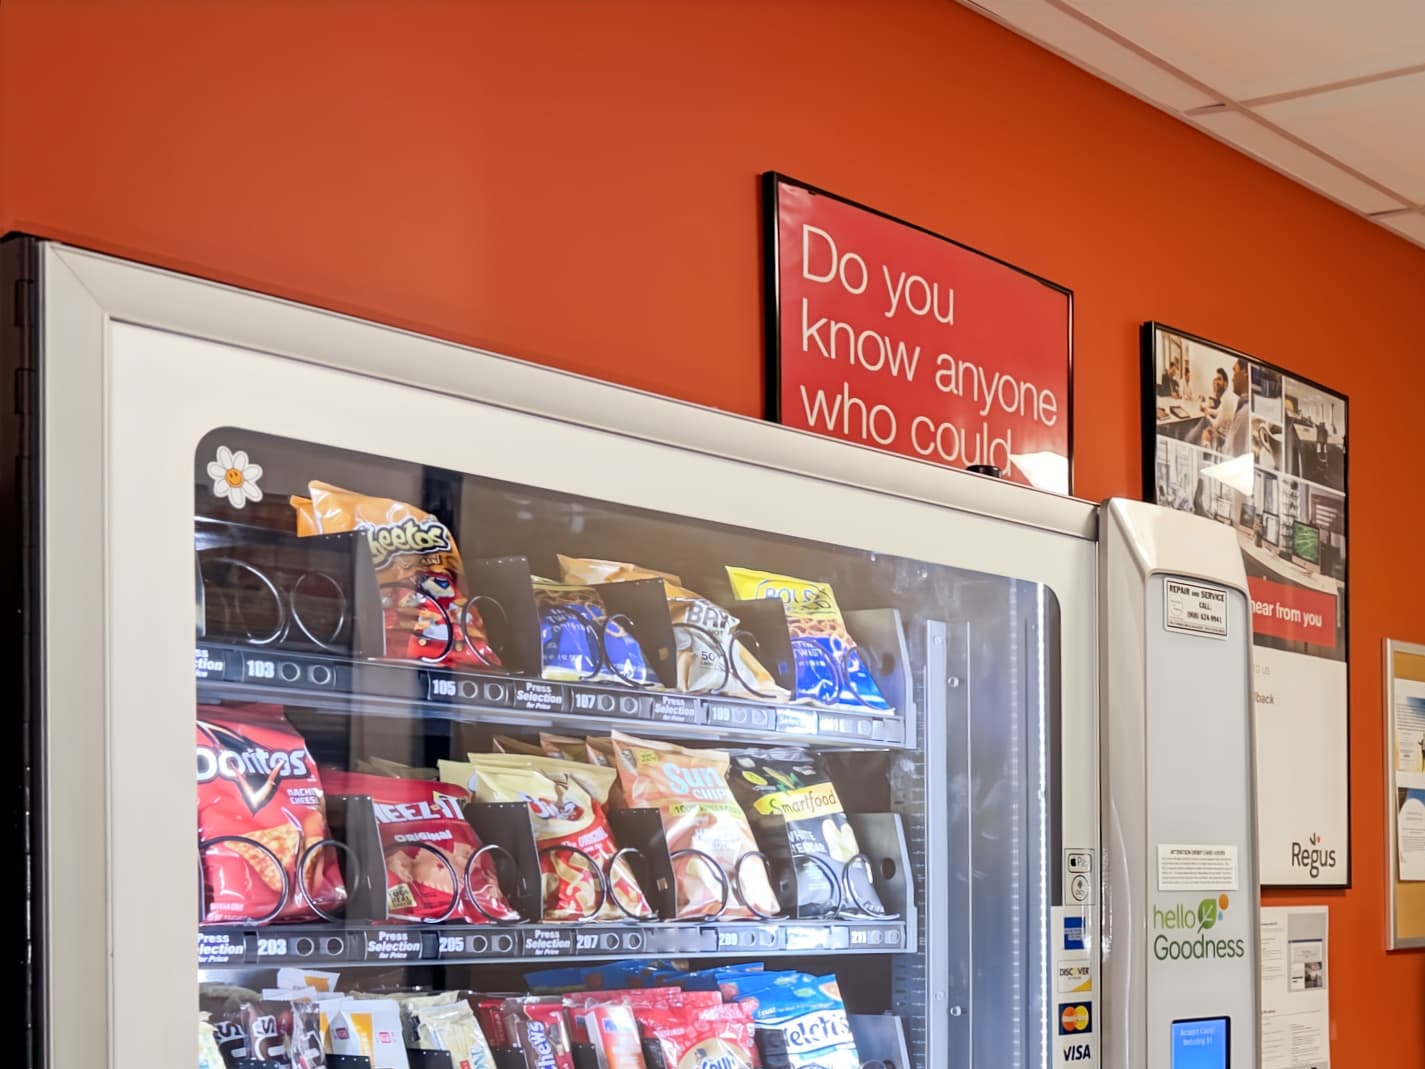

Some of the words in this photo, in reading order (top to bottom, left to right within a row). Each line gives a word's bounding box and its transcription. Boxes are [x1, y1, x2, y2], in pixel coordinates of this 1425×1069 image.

[803, 224, 868, 294] Do
[882, 265, 954, 325] you
[802, 298, 920, 381] know
[935, 353, 1057, 426] anyone
[800, 382, 896, 445] who
[911, 416, 1012, 477] could
[367, 519, 447, 565] heetos
[1276, 602, 1301, 622] from
[1303, 612, 1322, 628] you
[246, 660, 275, 678] 103
[432, 679, 456, 696] 105
[526, 682, 552, 693] Press
[516, 690, 562, 704] Selection
[575, 694, 596, 709] 107
[654, 703, 696, 716] Selection
[196, 747, 308, 780] Doritos
[663, 762, 720, 794] Sun
[769, 790, 837, 816] Smartfood
[1291, 842, 1336, 879] Regus
[1153, 904, 1195, 930] hello
[378, 931, 408, 941] Press
[534, 930, 559, 939] Press
[576, 934, 598, 949] 207
[197, 943, 244, 954] lection
[257, 939, 287, 955] 203
[368, 941, 421, 952] Selection
[439, 937, 463, 952] 205
[525, 938, 571, 949] Selection
[1153, 935, 1245, 961] Goodness
[1063, 1045, 1092, 1061] VISA
